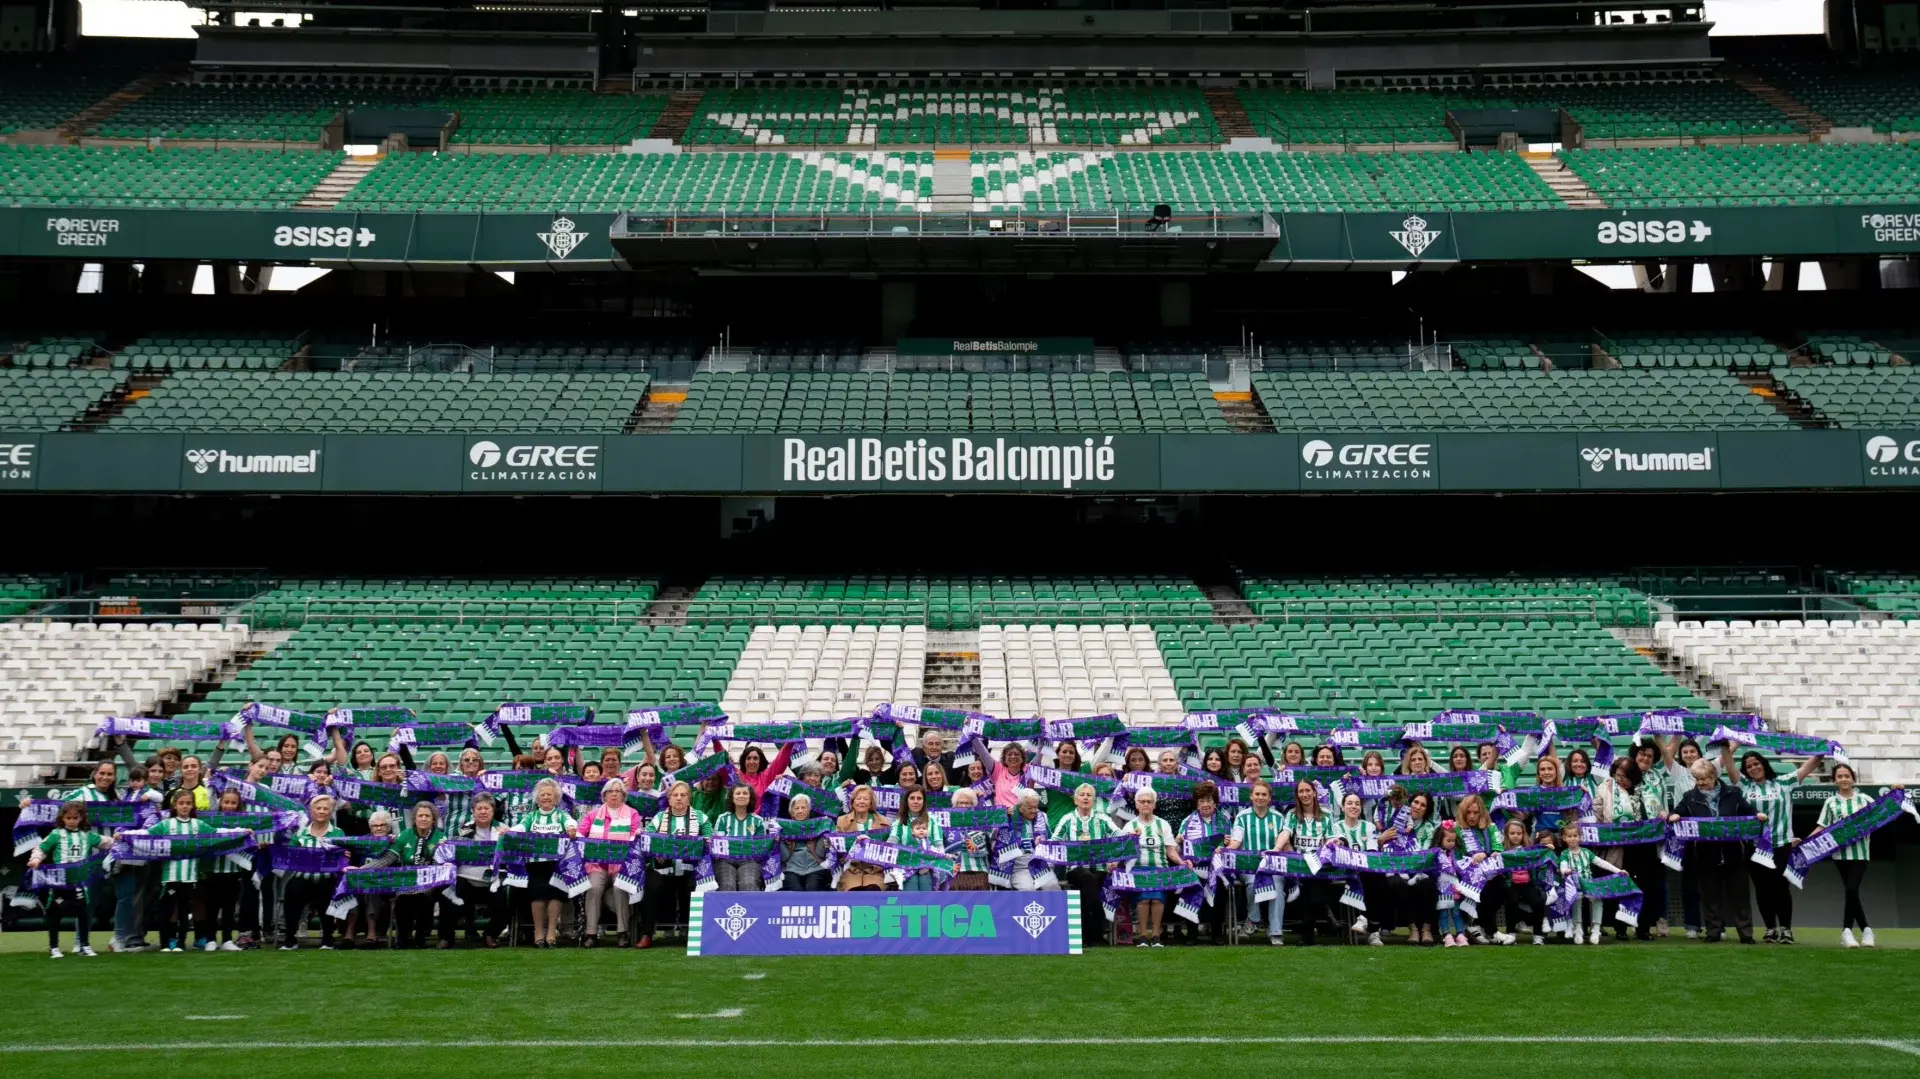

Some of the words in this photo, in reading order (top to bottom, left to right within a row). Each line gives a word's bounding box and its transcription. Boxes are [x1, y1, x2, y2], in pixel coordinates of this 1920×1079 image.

[47, 218, 119, 232] FOREVER
[1862, 214, 1920, 228] FOREVE
[57, 233, 107, 246] GREEN
[274, 226, 353, 247] asisa
[1598, 221, 1686, 243] asisa
[219, 449, 317, 473] hummel
[506, 446, 599, 466] GREE
[784, 438, 856, 481] Real
[862, 437, 946, 481] Betis
[952, 436, 1114, 488] Balompié
[1339, 444, 1430, 465] GREE
[1614, 447, 1711, 471] hummel
[471, 469, 597, 480] CLIMATIZACIÓN
[1305, 467, 1430, 479] CLIMATIZACIÓN
[500, 707, 531, 722] MUJER
[875, 789, 900, 809] UJER
[1673, 820, 1700, 838] UJER
[863, 843, 898, 865] MUJER
[781, 905, 851, 939] MUJER
[851, 897, 997, 938] BÉTICA
